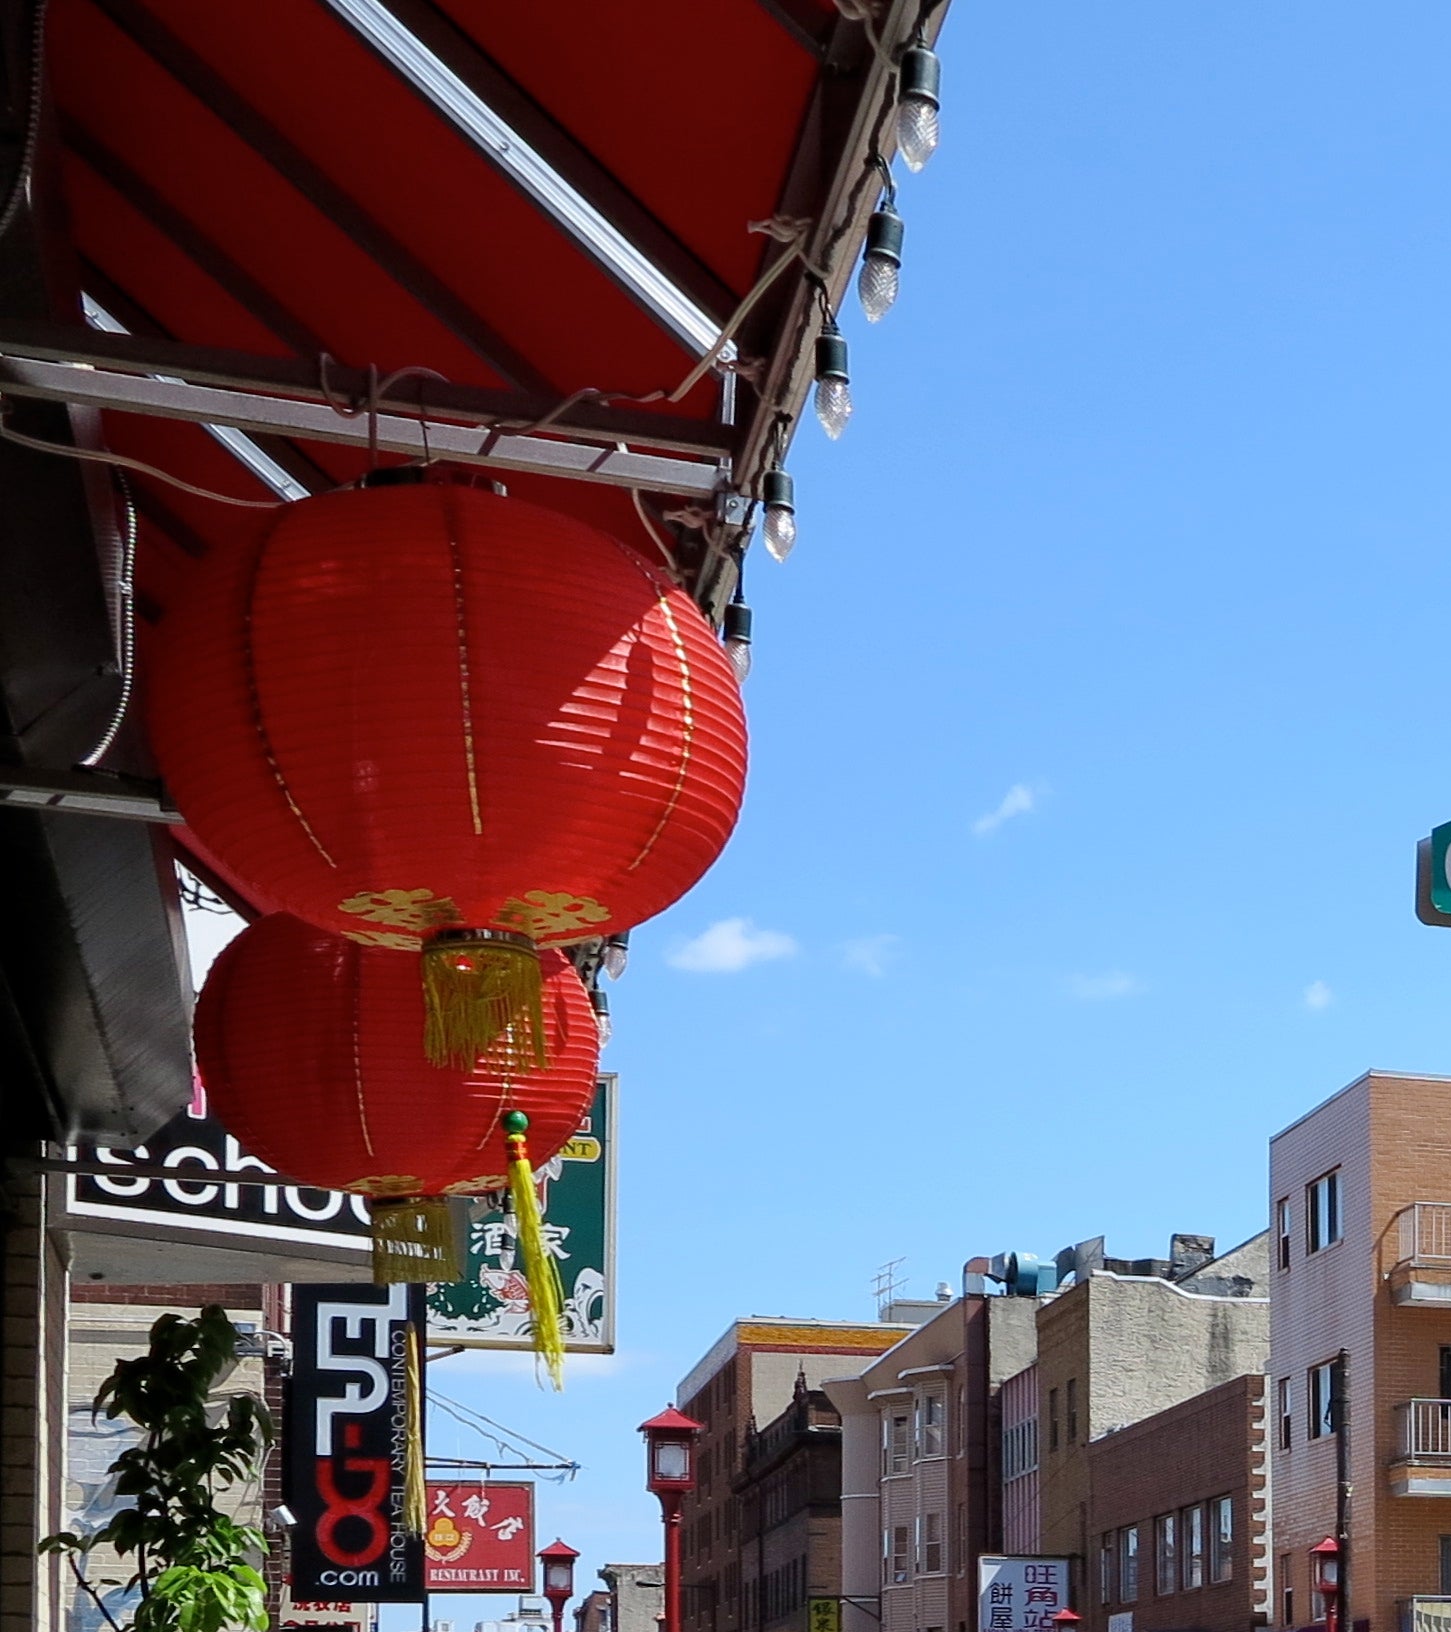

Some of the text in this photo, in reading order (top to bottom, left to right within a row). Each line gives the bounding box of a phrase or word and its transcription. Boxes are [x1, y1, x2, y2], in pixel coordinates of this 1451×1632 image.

[389, 1330, 407, 1583] CONTEMPORARY TEA HOUSE
[429, 1568, 499, 1582] RESTAURANT
